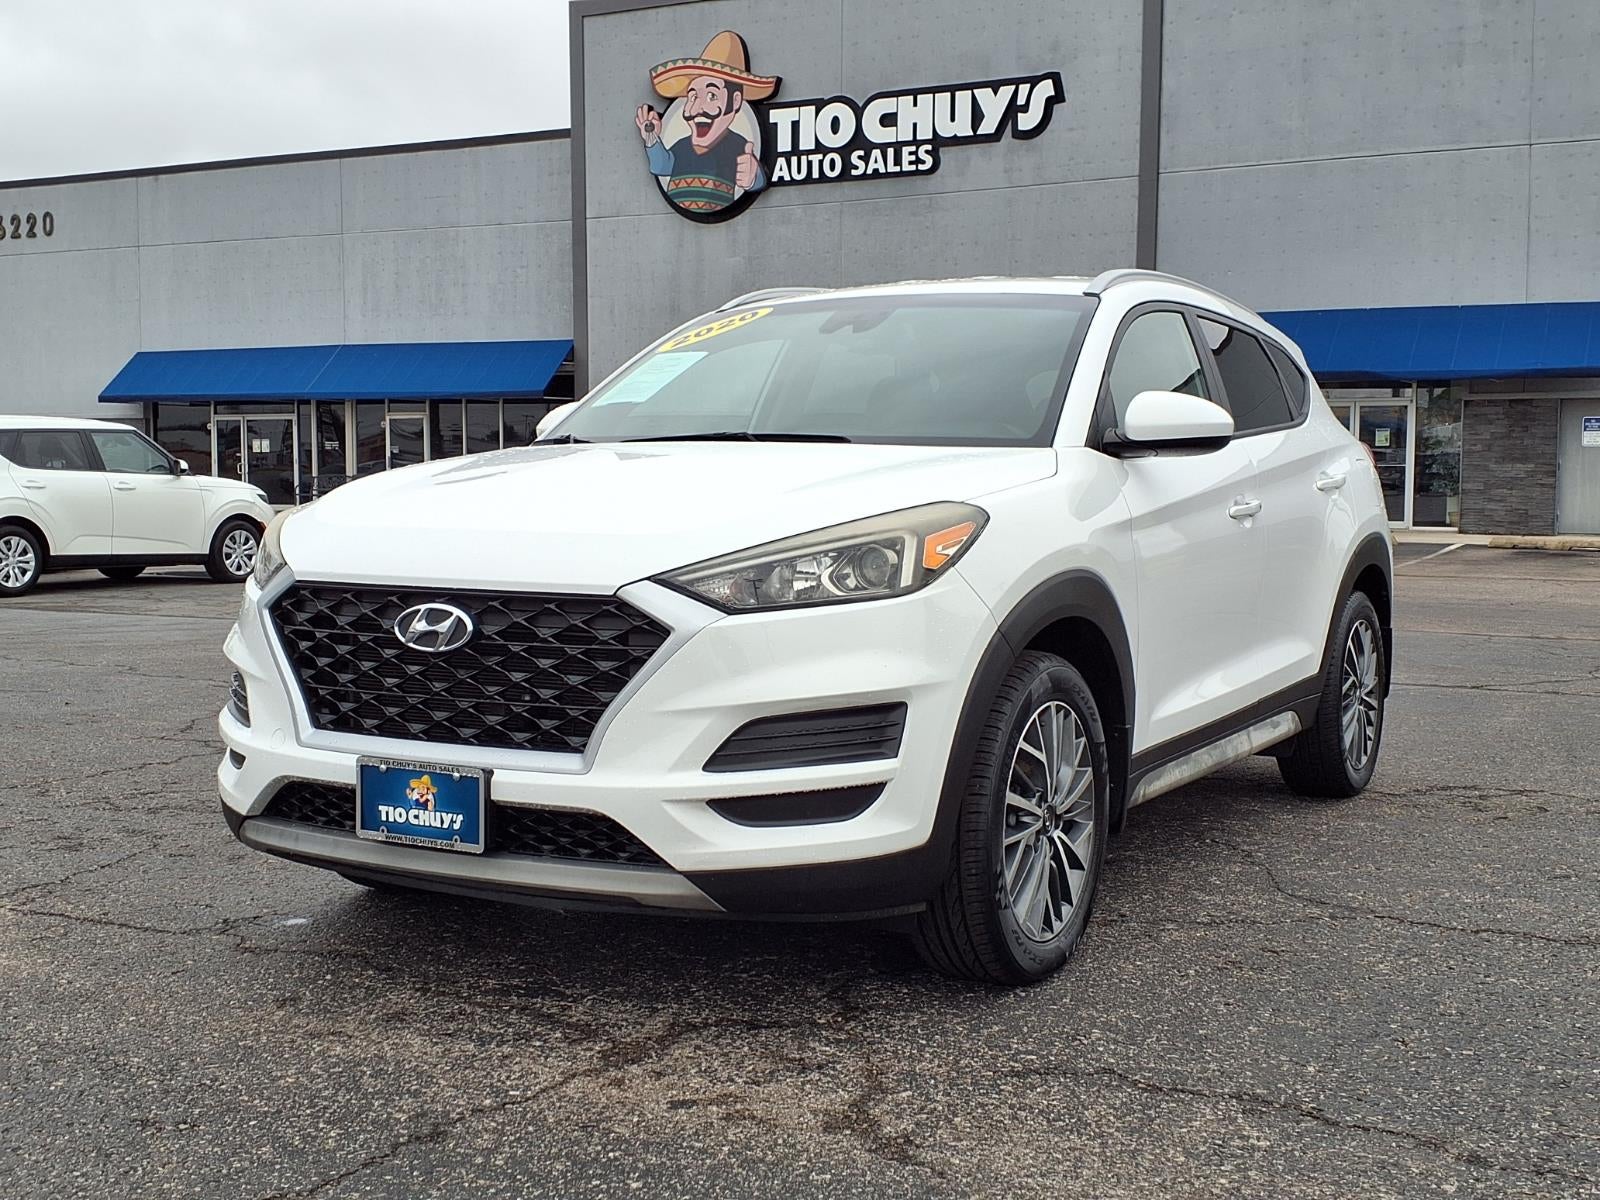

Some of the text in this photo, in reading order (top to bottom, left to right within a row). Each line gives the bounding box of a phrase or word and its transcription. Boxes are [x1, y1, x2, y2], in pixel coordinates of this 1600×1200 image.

[769, 78, 1055, 152] TIO CHUY'S
[771, 145, 933, 182] AUTO SALES
[671, 311, 760, 348] 2020
[418, 763, 437, 771] AUTO
[438, 766, 460, 774] SALES
[378, 805, 464, 830] TIO CHUY'S
[384, 834, 455, 848] WWW.TIOCHUYS.COM
